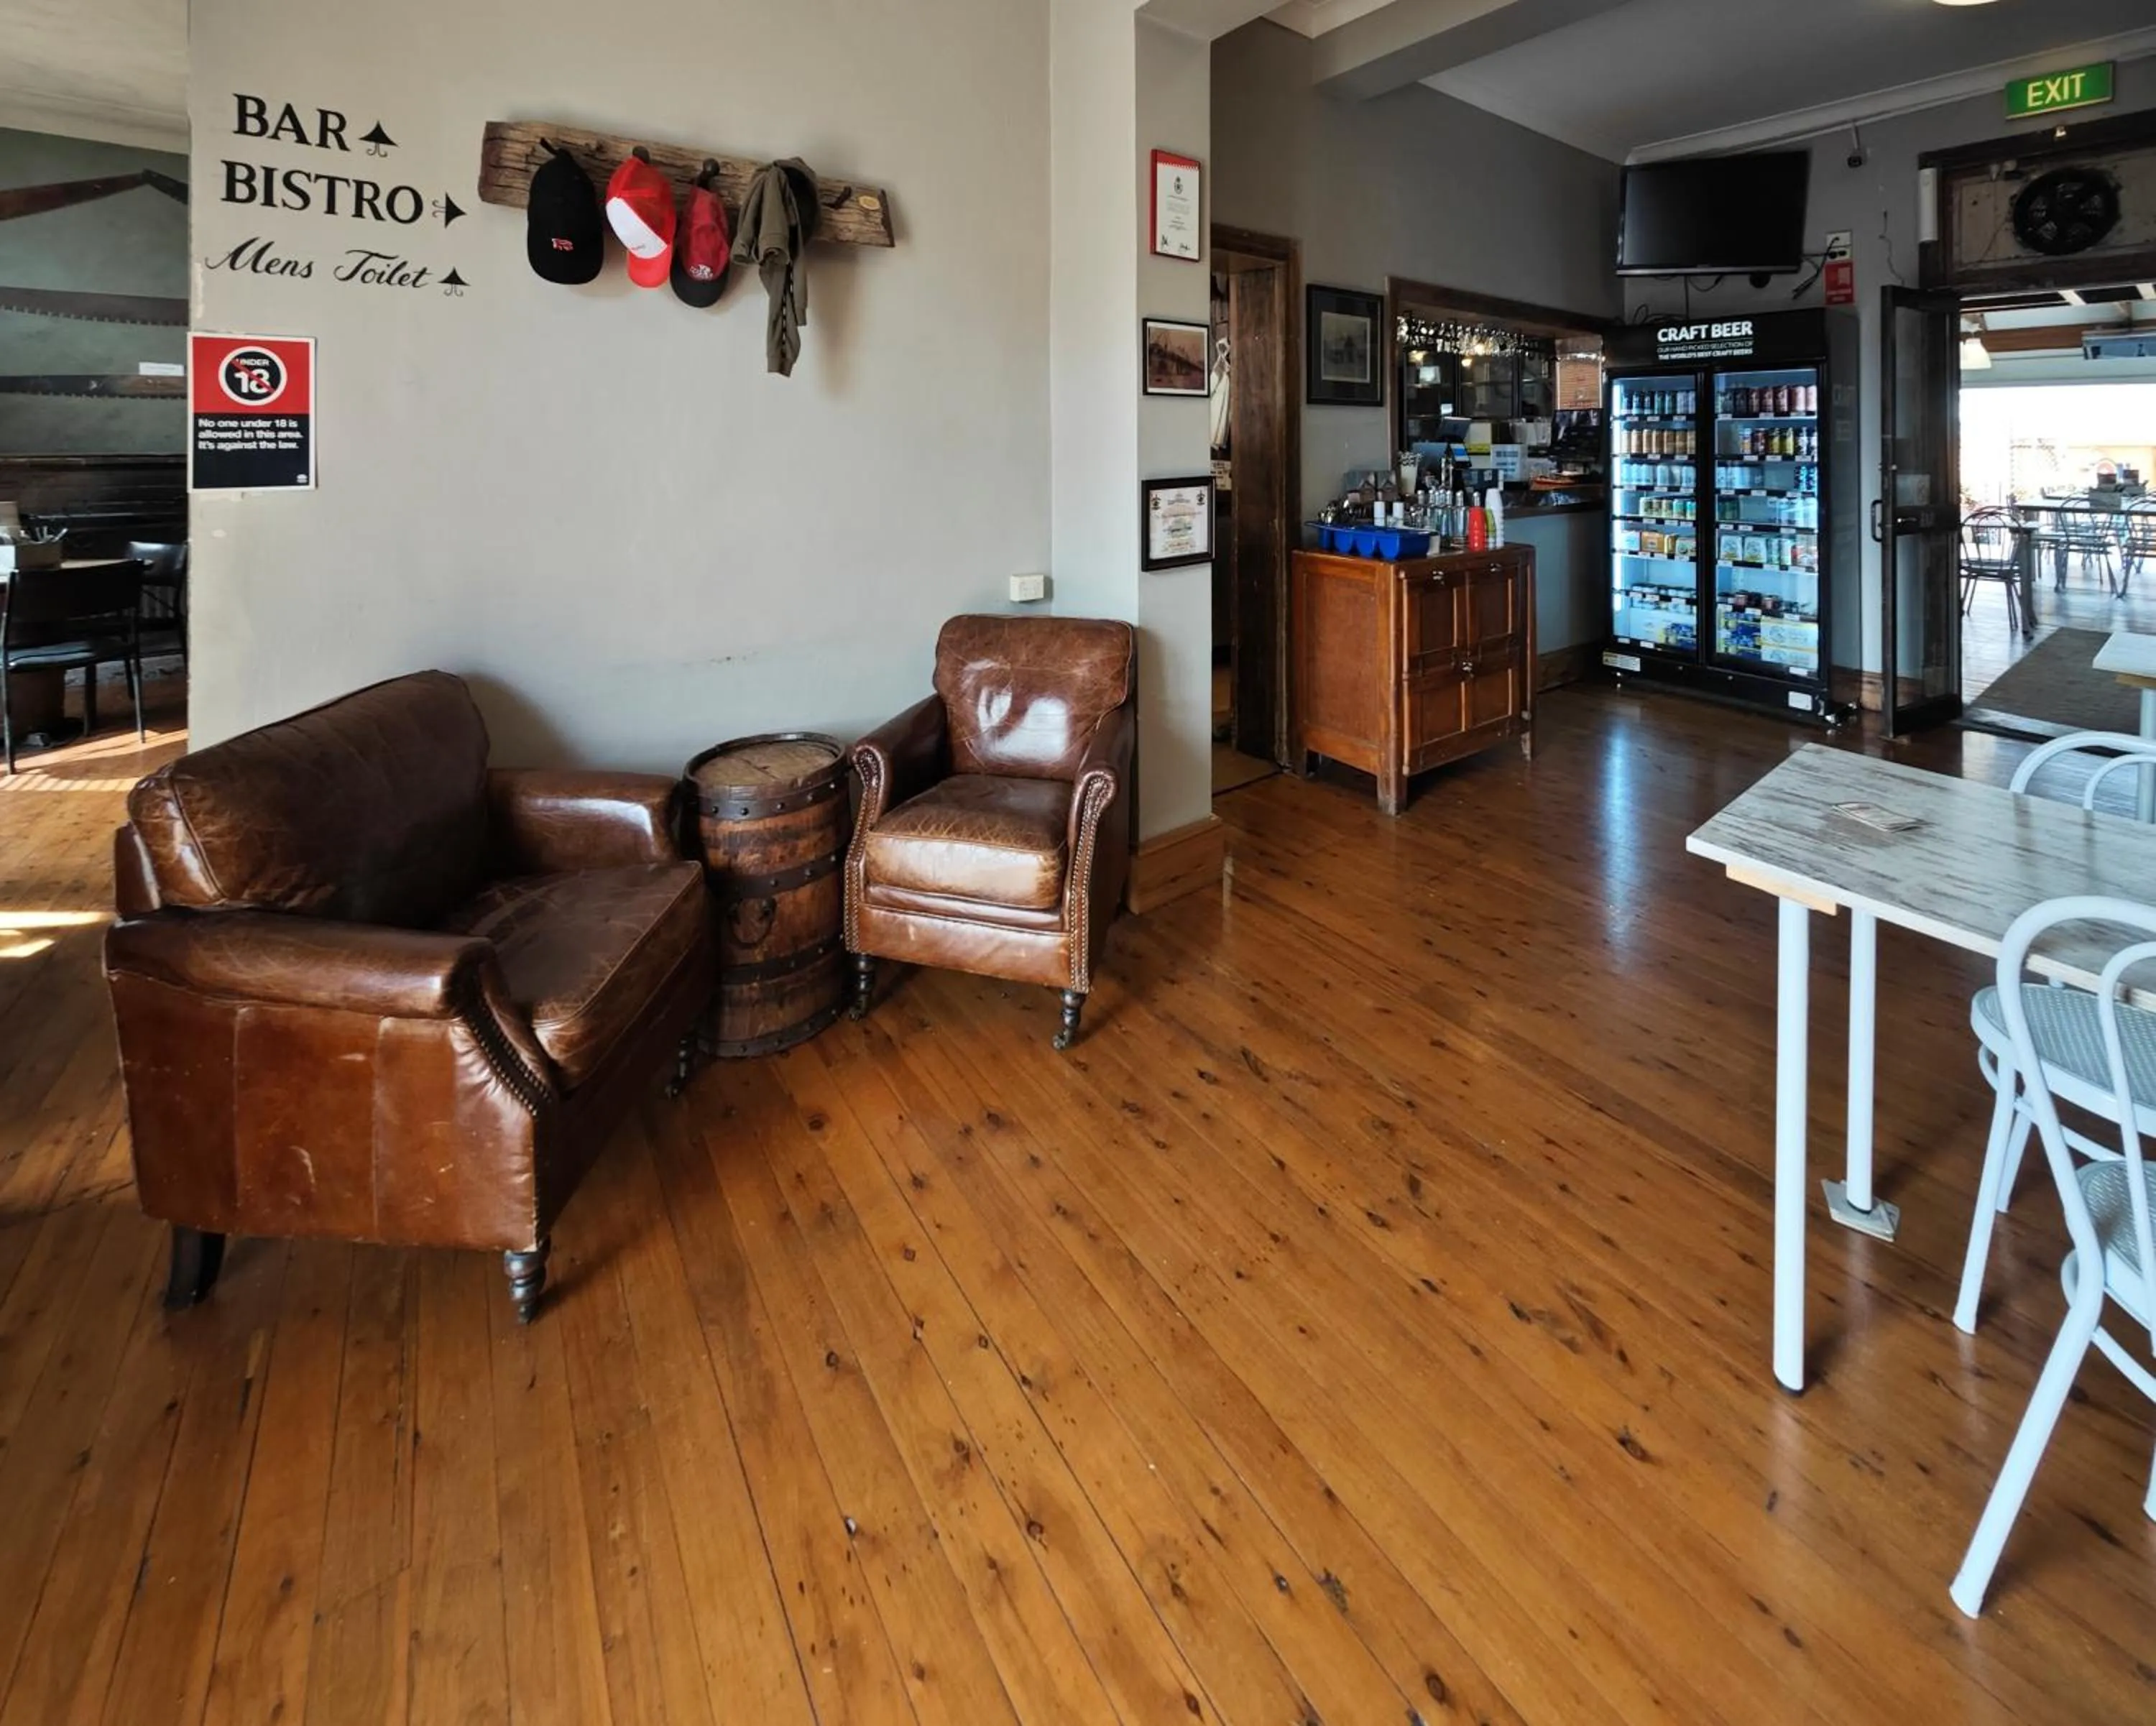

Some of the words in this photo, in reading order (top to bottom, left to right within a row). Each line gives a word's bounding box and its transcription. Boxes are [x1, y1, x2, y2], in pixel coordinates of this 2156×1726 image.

[2027, 73, 2086, 107] EXIT
[232, 93, 351, 152] BAR
[220, 160, 424, 224] BISTRO
[204, 236, 313, 279] Mens
[334, 249, 433, 289] Toilet
[1657, 325, 1709, 342] CRAFT
[1711, 321, 1753, 338] BEER
[234, 368, 270, 394] 18
[198, 419, 214, 428] No
[241, 419, 272, 428] under
[288, 419, 298, 428] is
[198, 430, 241, 438] allowed
[244, 430, 254, 438] in
[256, 430, 275, 438] this
[217, 441, 257, 451] against
